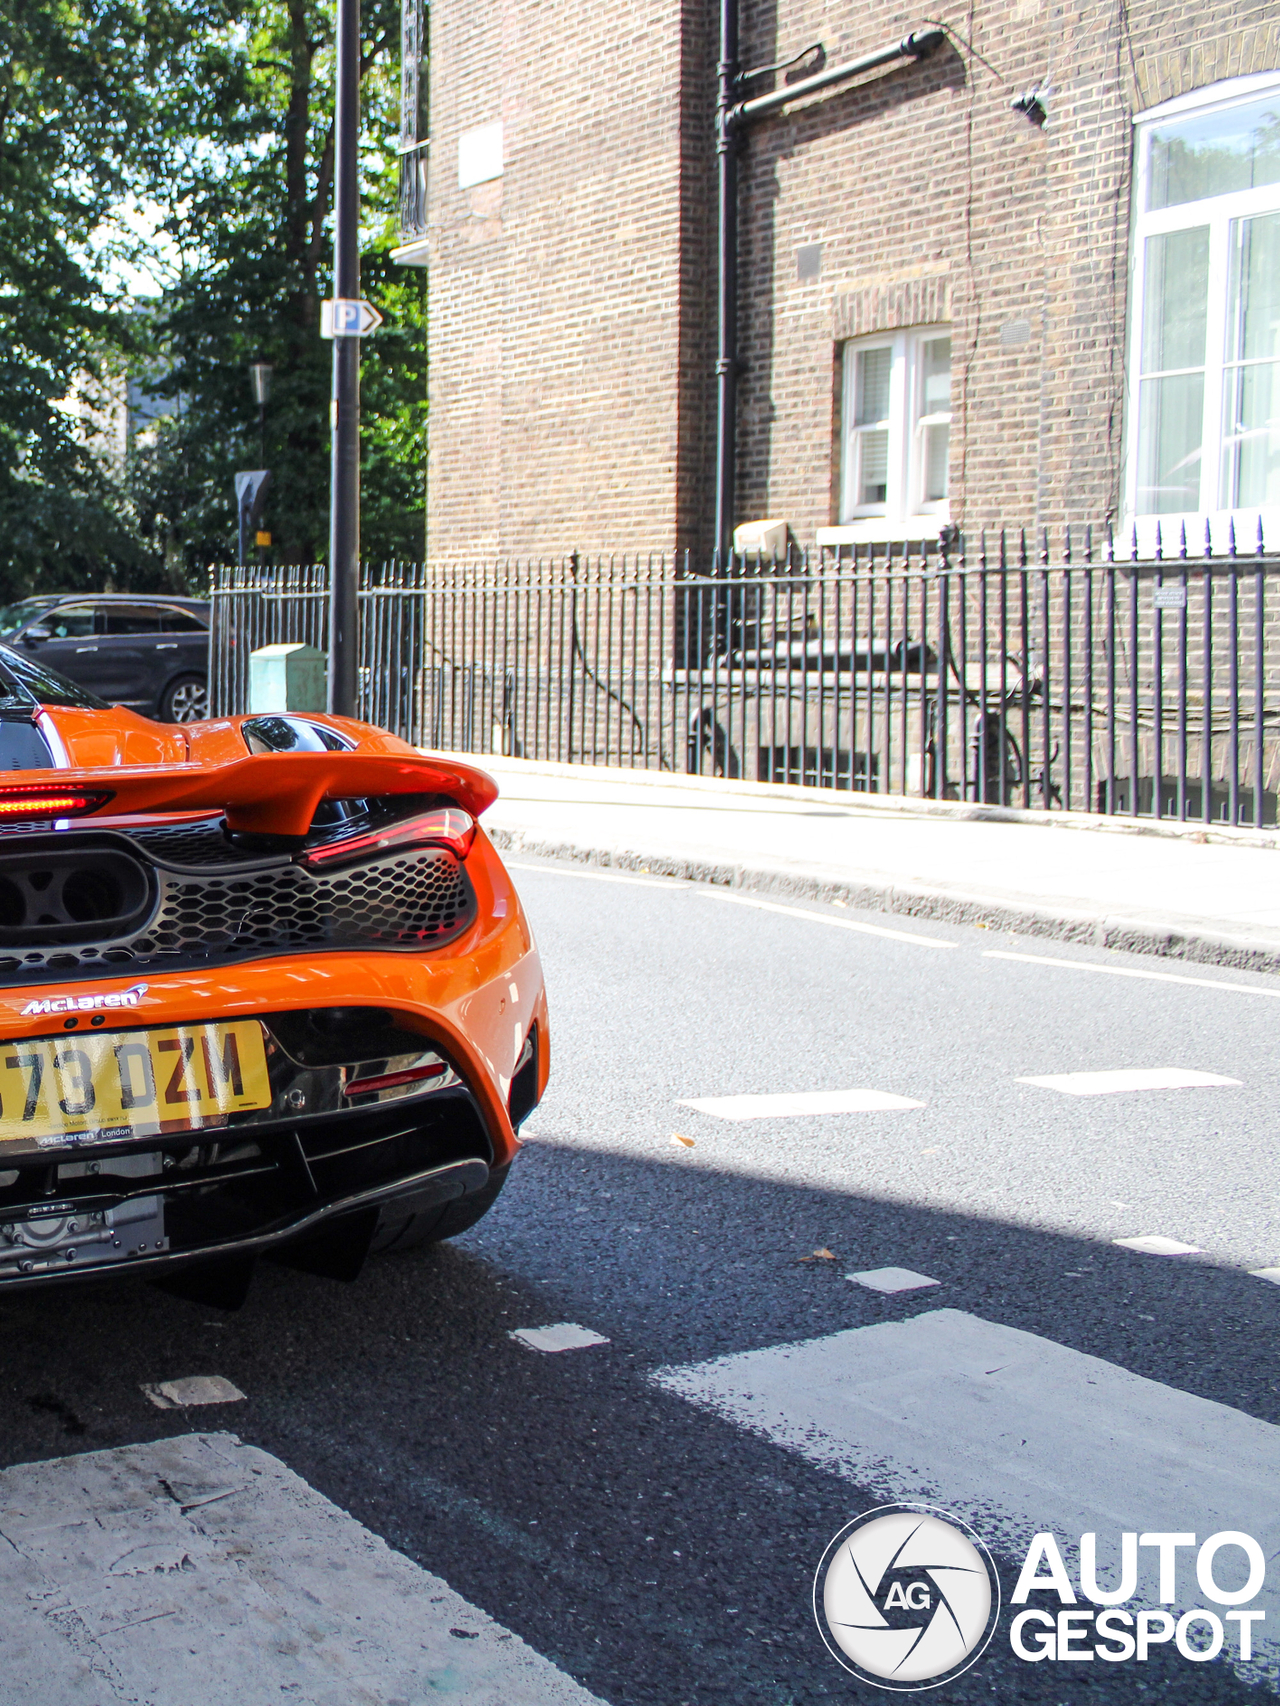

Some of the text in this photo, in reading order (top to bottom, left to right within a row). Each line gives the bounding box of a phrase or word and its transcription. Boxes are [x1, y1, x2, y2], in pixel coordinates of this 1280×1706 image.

[338, 304, 357, 328] P
[19, 993, 138, 1015] McLaren
[113, 1032, 244, 1110] DZM
[39, 1128, 131, 1145] McLaren London
